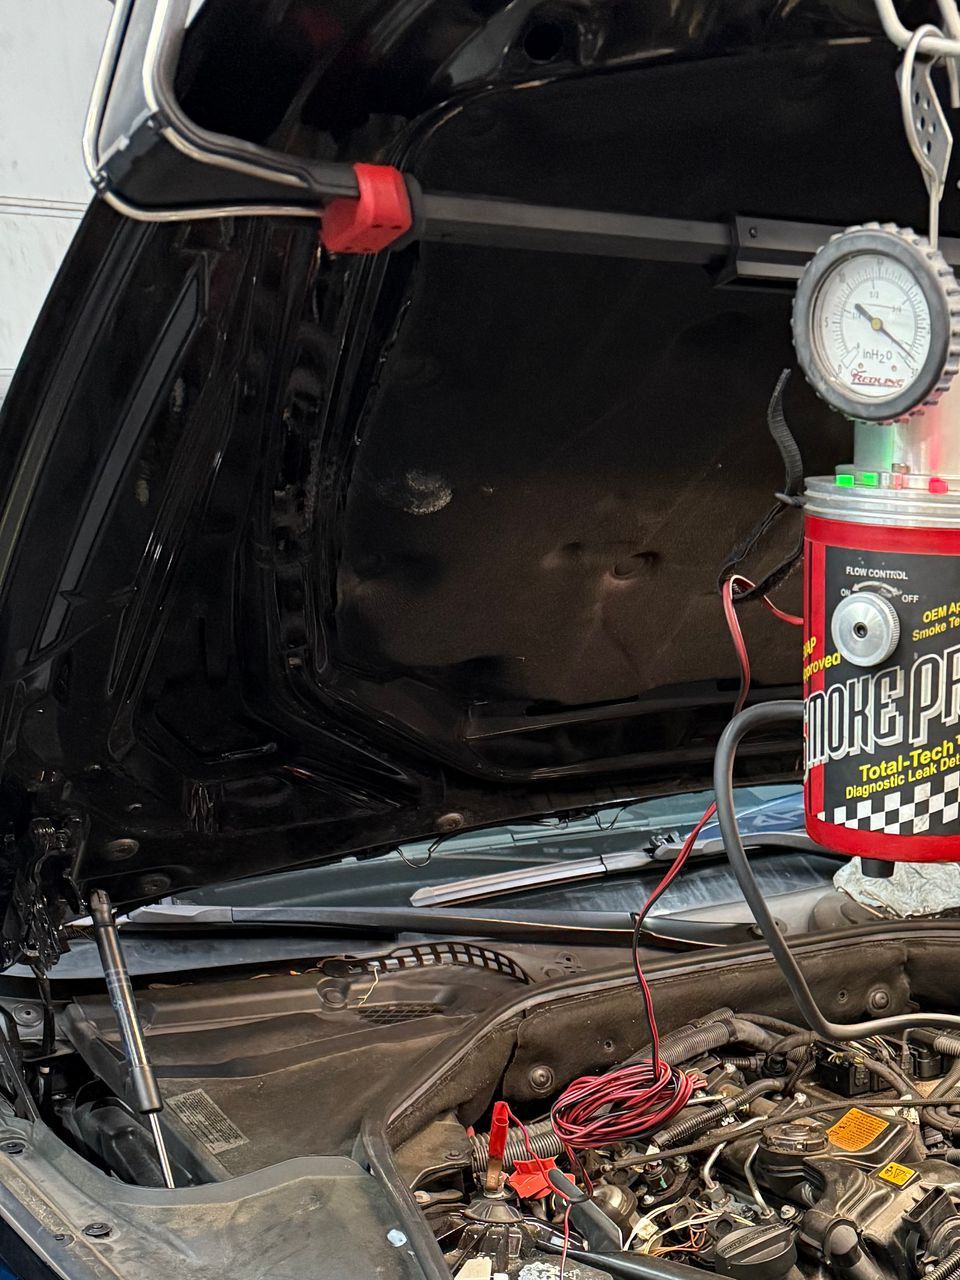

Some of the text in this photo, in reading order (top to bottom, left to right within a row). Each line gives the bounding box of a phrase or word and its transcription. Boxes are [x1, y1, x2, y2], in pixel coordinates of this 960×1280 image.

[845, 565, 909, 580] FLOW CONTROL
[840, 588, 851, 597] ON
[901, 594, 920, 604] OFF
[922, 604, 947, 623] OEM
[911, 622, 947, 642] Smoke
[803, 665, 904, 774] MOKE
[859, 739, 954, 782] Total-Tech
[845, 773, 905, 799] Diagnostic
[907, 762, 938, 783] Leak
